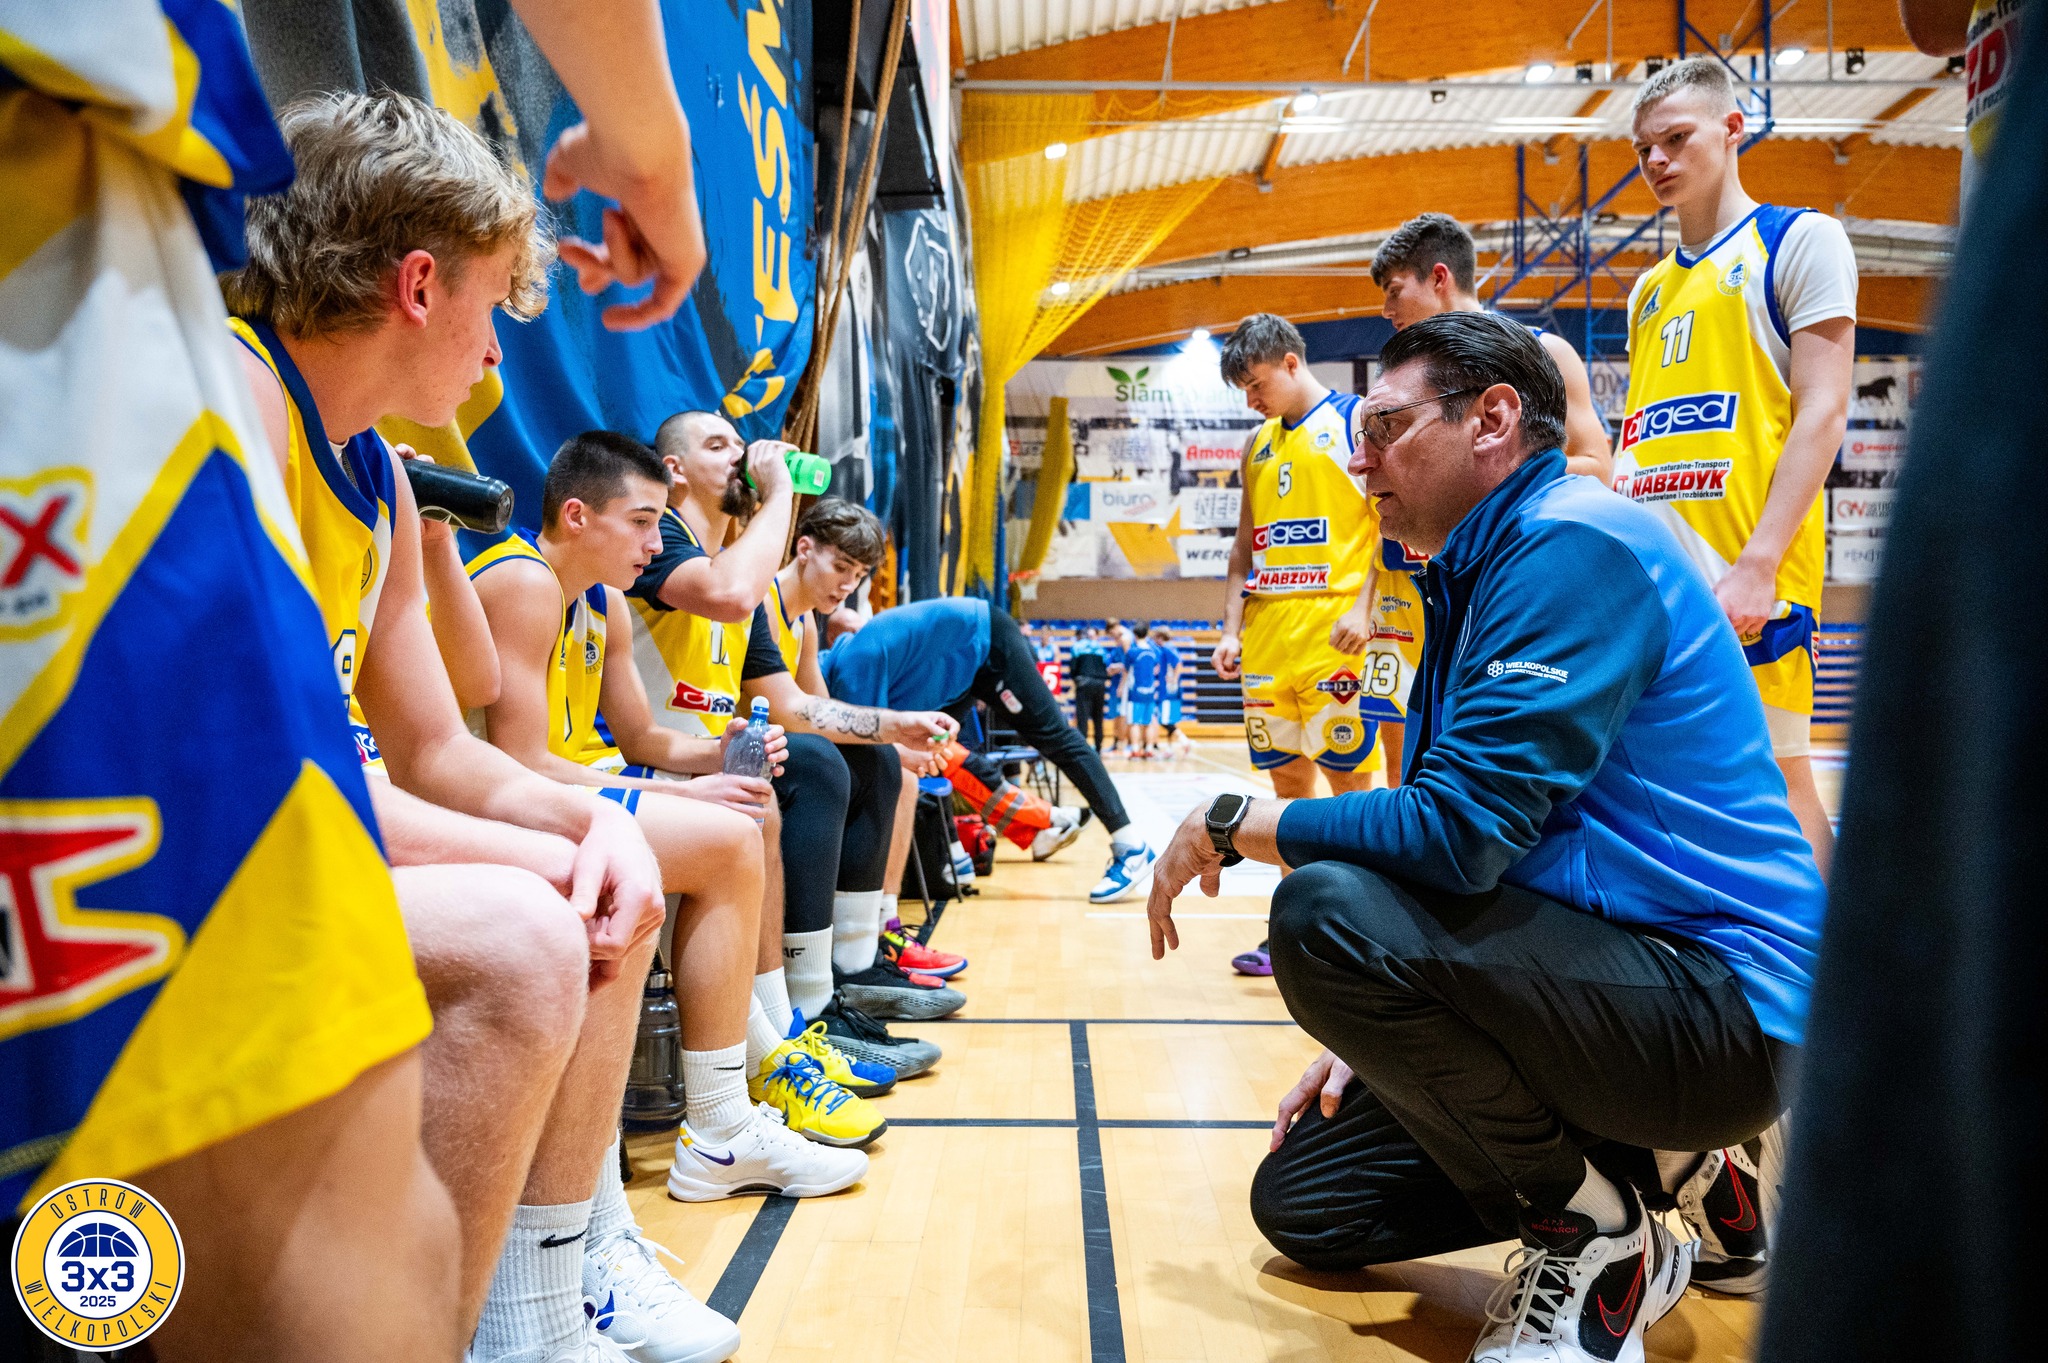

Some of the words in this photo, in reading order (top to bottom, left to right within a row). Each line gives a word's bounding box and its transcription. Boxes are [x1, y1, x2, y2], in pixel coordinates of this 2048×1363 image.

[1661, 310, 1695, 368] 11
[1628, 394, 1730, 440] arged
[1660, 460, 1730, 471] naturalne-Transport
[1277, 461, 1292, 499] 5
[1632, 470, 1728, 498] NABZDYK
[1102, 490, 1153, 506] biuro
[1646, 493, 1677, 502] budowlane
[1259, 571, 1328, 585] NABZDYK
[1362, 651, 1400, 697] 13
[1505, 661, 1569, 678] WIELKOPOLSKIE
[1248, 717, 1272, 753] 5
[1531, 1223, 1578, 1234] MONARCH
